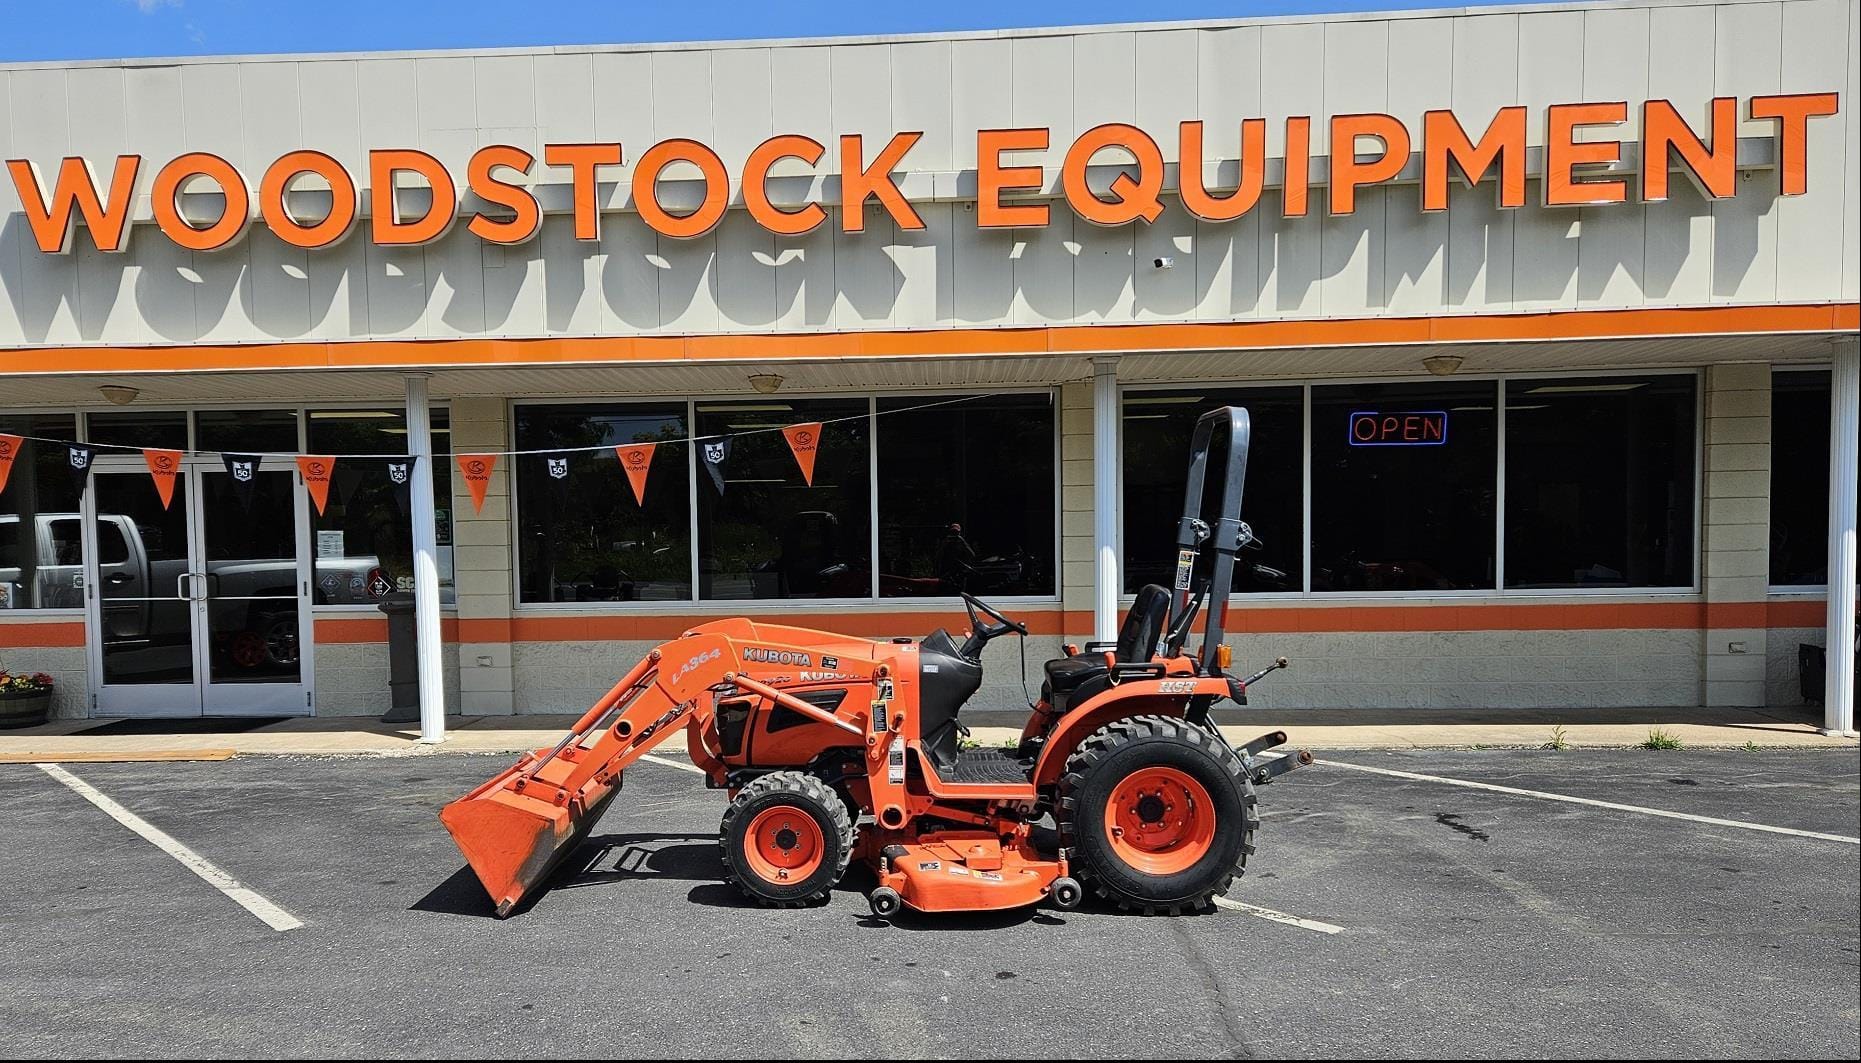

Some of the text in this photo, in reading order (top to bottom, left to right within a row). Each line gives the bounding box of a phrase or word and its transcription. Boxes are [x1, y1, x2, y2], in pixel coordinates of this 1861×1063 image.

[7, 92, 1839, 253] WOODSTOCK EQUIPMENT
[1354, 416, 1442, 441] OPEN
[672, 648, 721, 685] LA364
[743, 646, 812, 667] KUBOTA
[1158, 680, 1198, 693] HST
